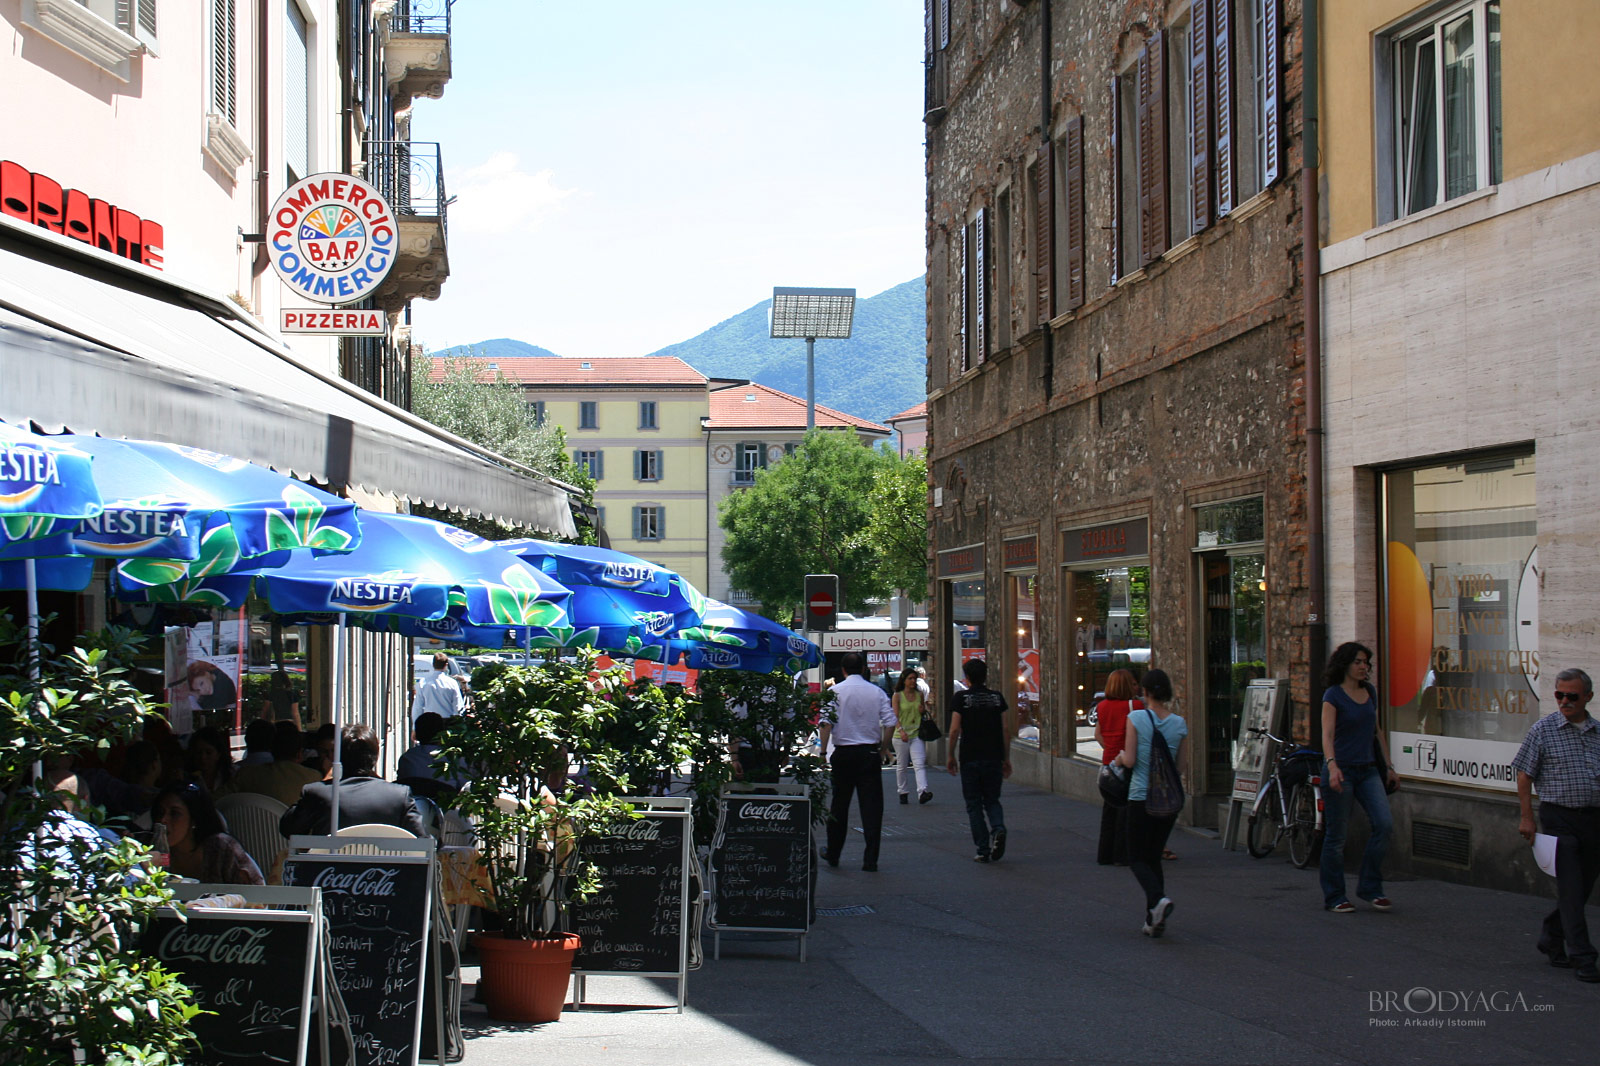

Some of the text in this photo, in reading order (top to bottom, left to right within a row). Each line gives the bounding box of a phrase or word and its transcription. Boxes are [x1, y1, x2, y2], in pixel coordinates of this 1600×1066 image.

[273, 179, 393, 251] COMMERCIO
[302, 207, 363, 239] SNACK
[273, 226, 393, 297] COMMERCIO
[307, 240, 359, 262] BAR
[285, 313, 380, 328] PIZZERIA
[80, 509, 189, 537] NESTEA
[1081, 527, 1127, 550] STORICA
[606, 562, 655, 583] NESTEA
[336, 578, 412, 604] NESTEA
[1435, 573, 1495, 599] CAMBIO
[1435, 610, 1505, 635] CHANGE
[830, 636, 876, 650] Lugano
[1436, 686, 1529, 714] EXCHANGE
[1443, 758, 1479, 778] NUOVO
[312, 866, 400, 897] Coca-Cola
[158, 923, 273, 965] Coca-Cola
